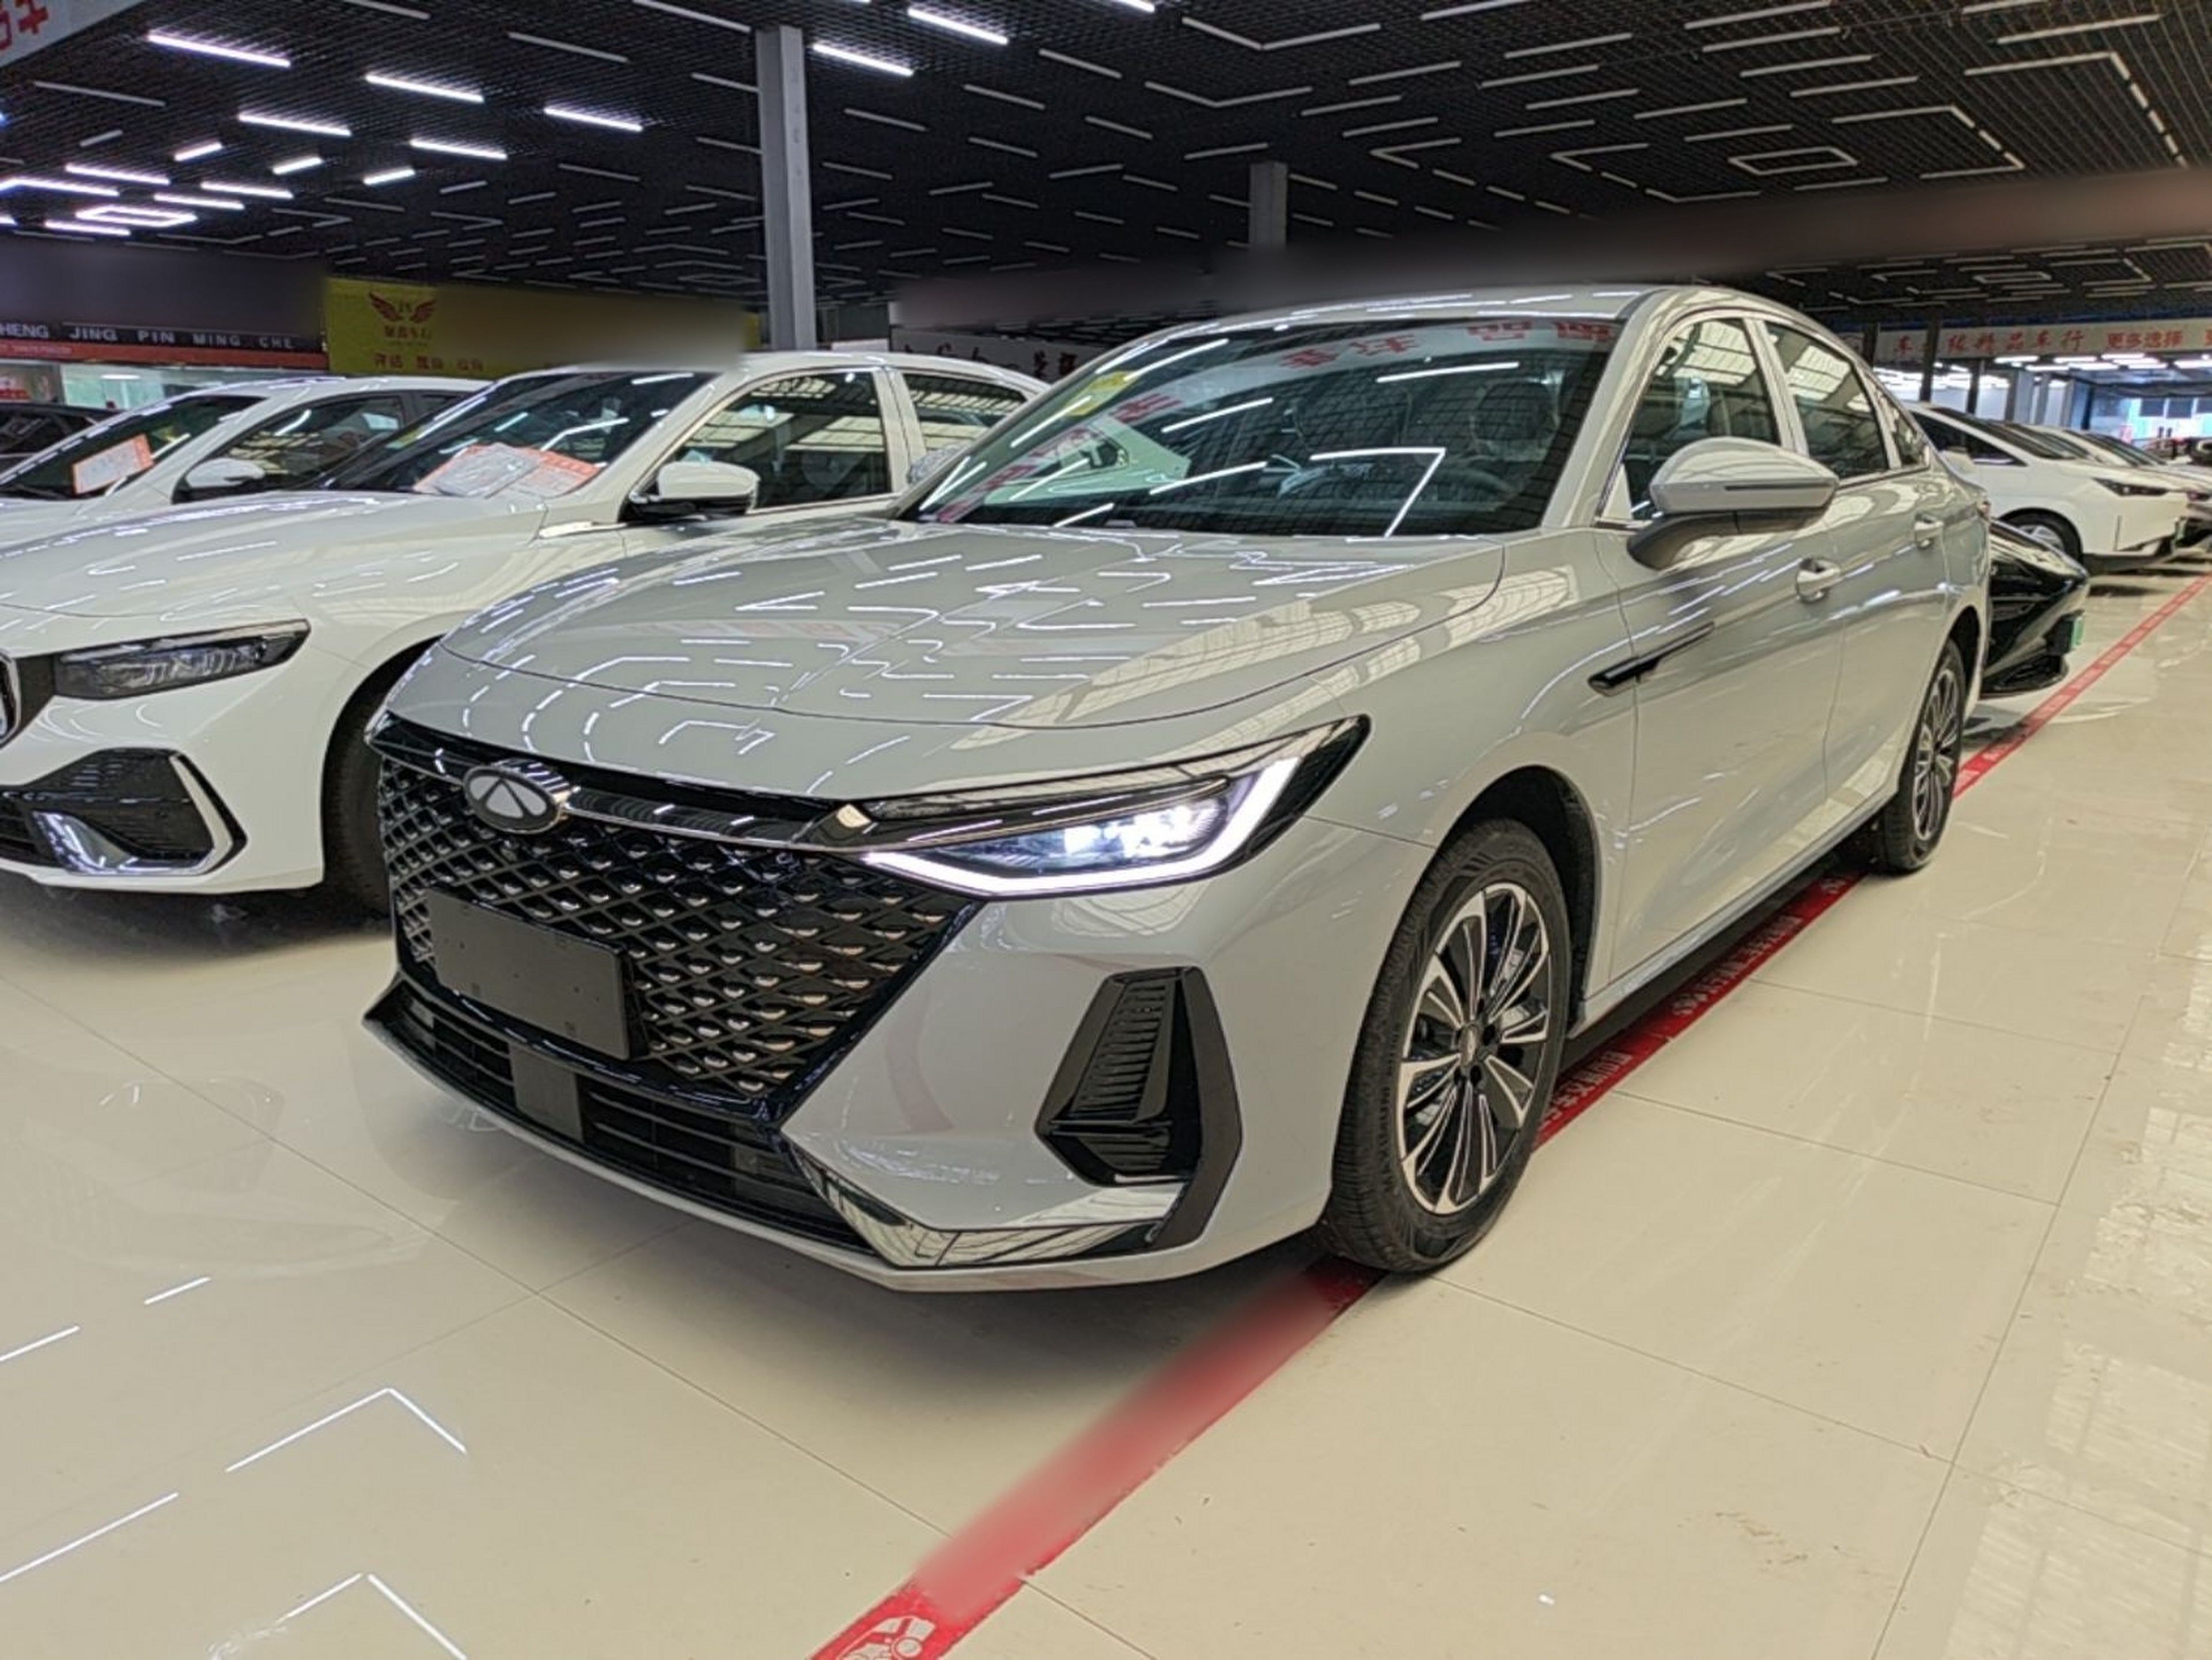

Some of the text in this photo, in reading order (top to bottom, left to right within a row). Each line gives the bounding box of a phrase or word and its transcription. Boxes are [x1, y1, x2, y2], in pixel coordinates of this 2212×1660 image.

[69, 327, 117, 341] JING
[137, 330, 175, 343] PIN
[193, 333, 240, 346] MING
